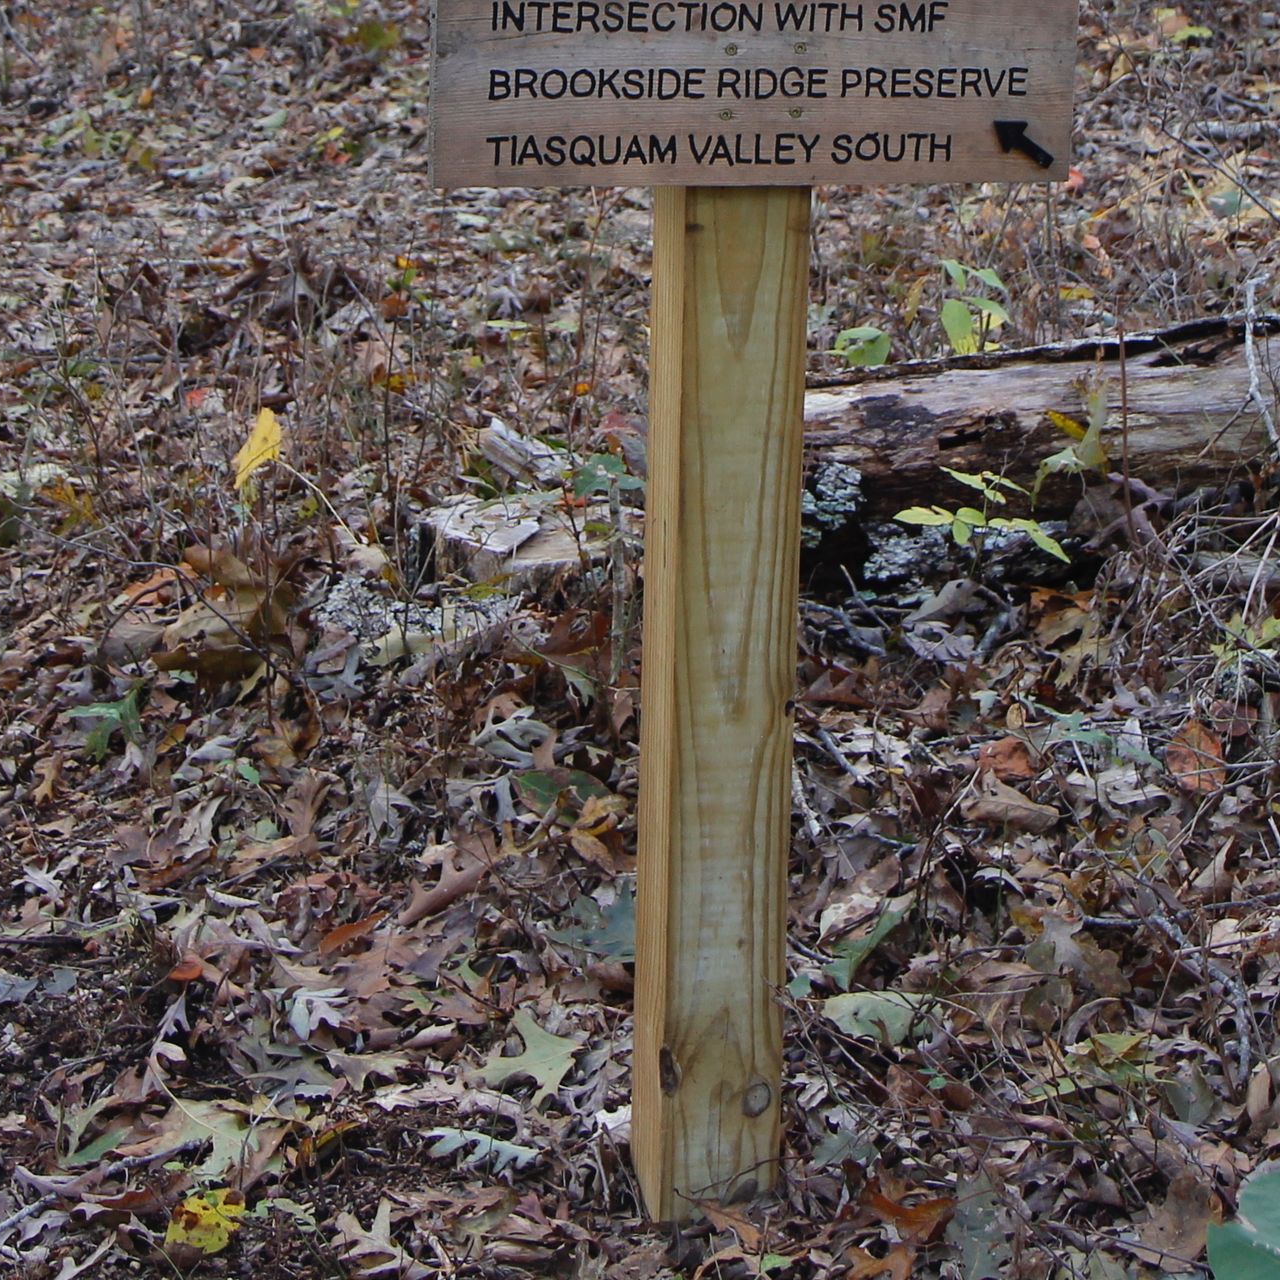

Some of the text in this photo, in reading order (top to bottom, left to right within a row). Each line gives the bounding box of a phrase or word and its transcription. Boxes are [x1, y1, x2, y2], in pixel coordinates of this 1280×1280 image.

[491, 0, 949, 34] INTERSECTION WITH SMF
[487, 66, 1029, 102] BROOKSIDE RIDGE PRESERVE
[485, 131, 952, 168] TIASQUAM VALLEY SOUTH
